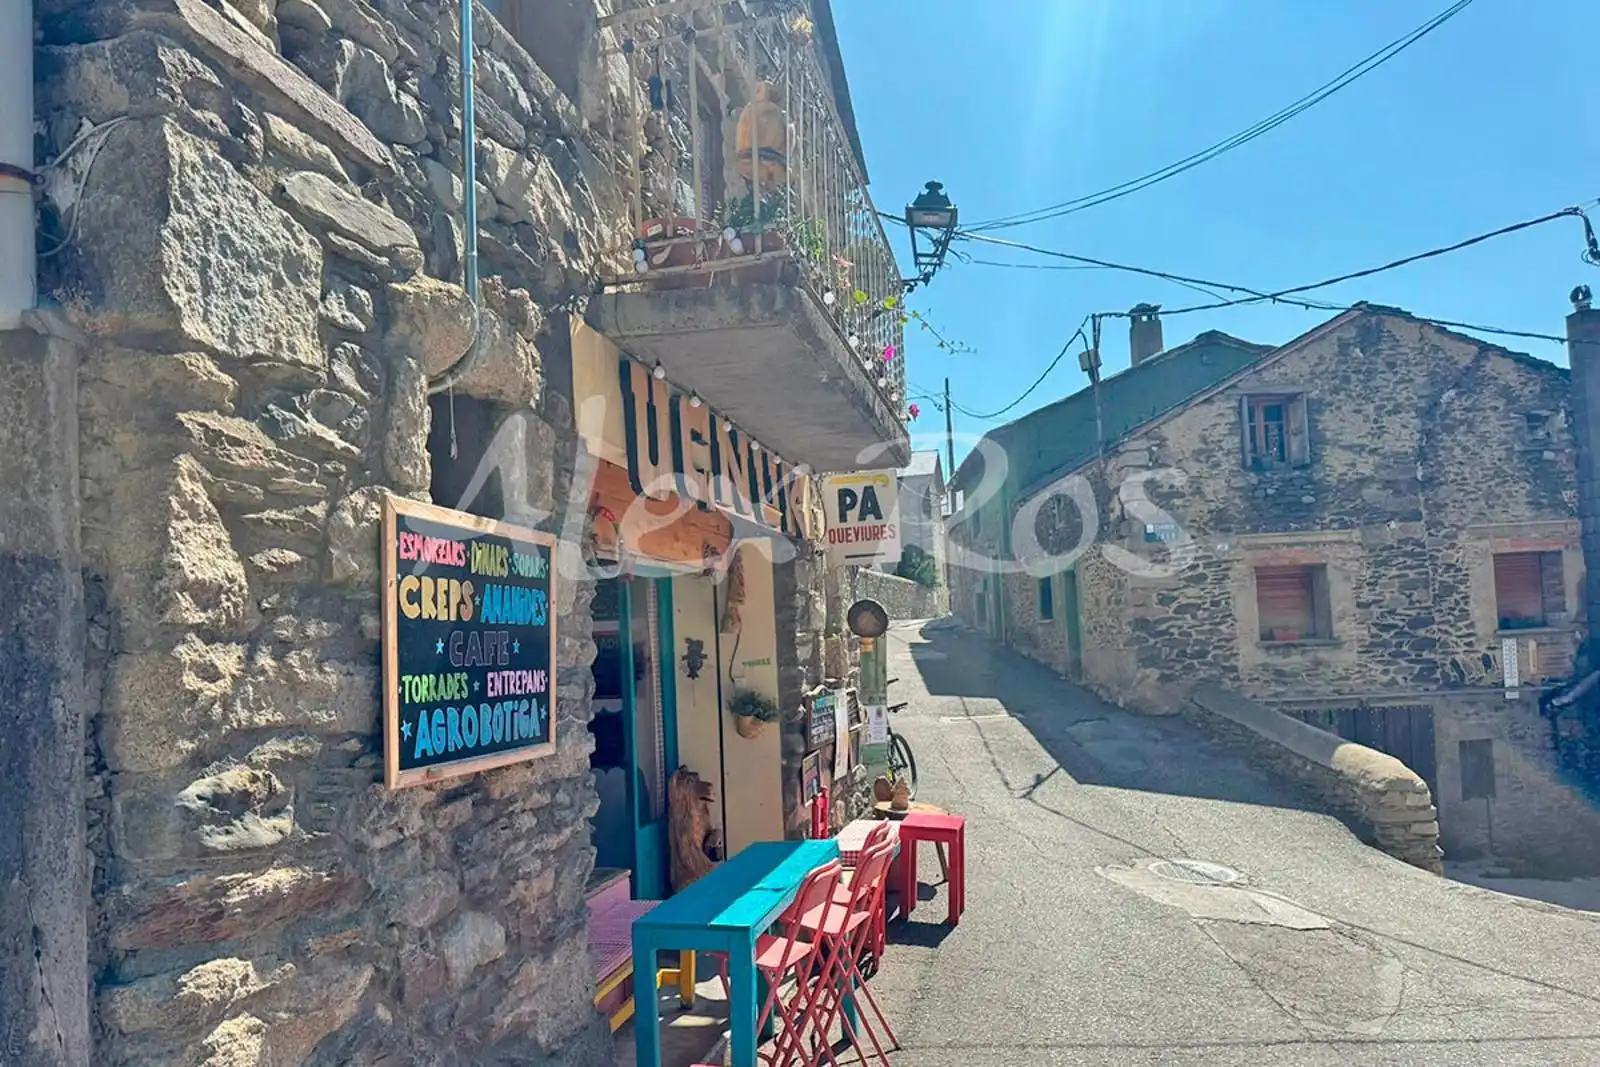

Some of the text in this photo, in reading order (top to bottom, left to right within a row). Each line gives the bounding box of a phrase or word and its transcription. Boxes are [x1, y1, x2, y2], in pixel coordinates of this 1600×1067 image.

[838, 485, 883, 523] PA
[828, 524, 896, 544] QUEVIURES
[399, 575, 474, 622] CREPS
[449, 630, 510, 668] CAFE
[401, 669, 546, 704] TORRADES ENTREPANS
